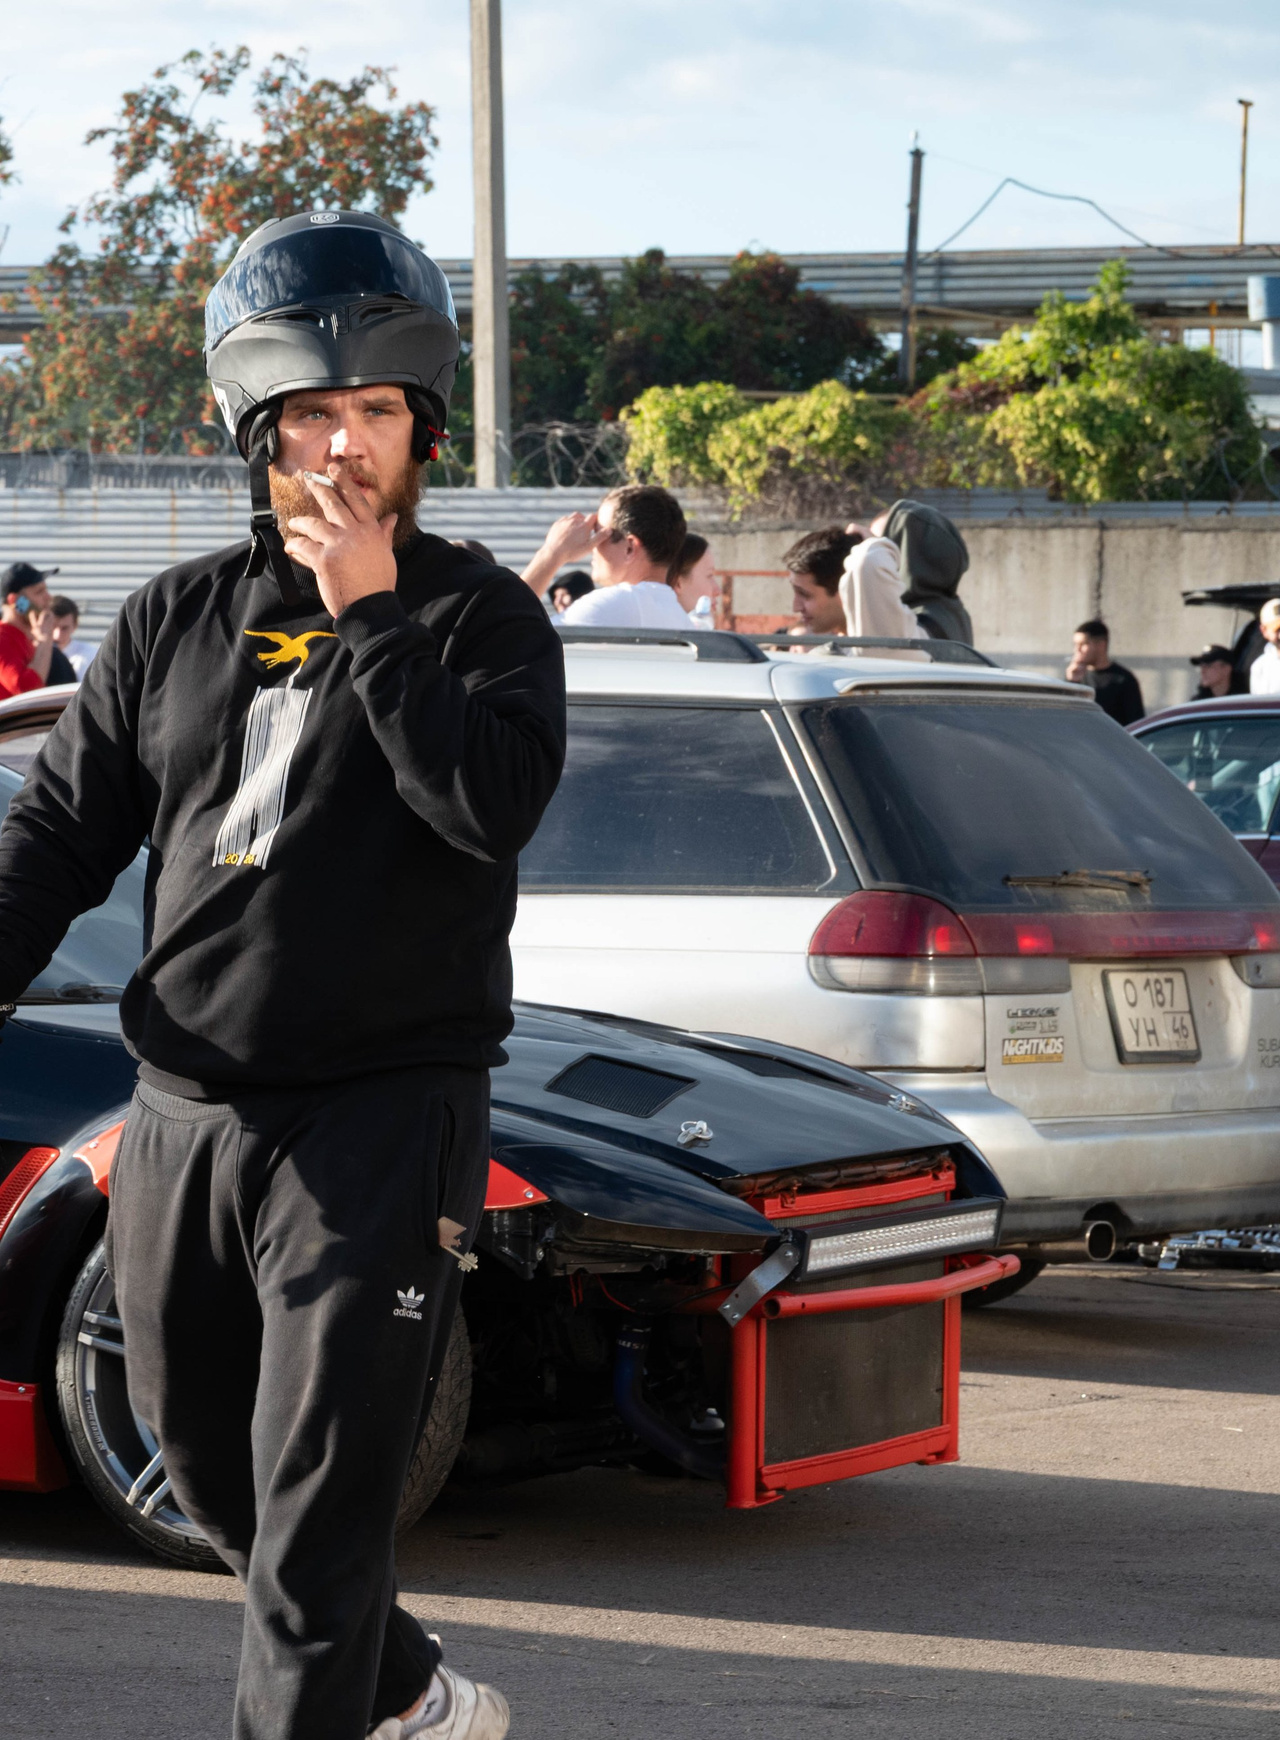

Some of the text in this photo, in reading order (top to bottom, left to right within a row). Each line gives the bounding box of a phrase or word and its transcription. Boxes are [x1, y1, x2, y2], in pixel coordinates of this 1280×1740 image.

[225, 853, 238, 864] 20
[1143, 977, 1174, 1008] 187
[1172, 1016, 1190, 1039] 46
[1257, 1038, 1280, 1052] SUB
[393, 1307, 423, 1320] adidas
